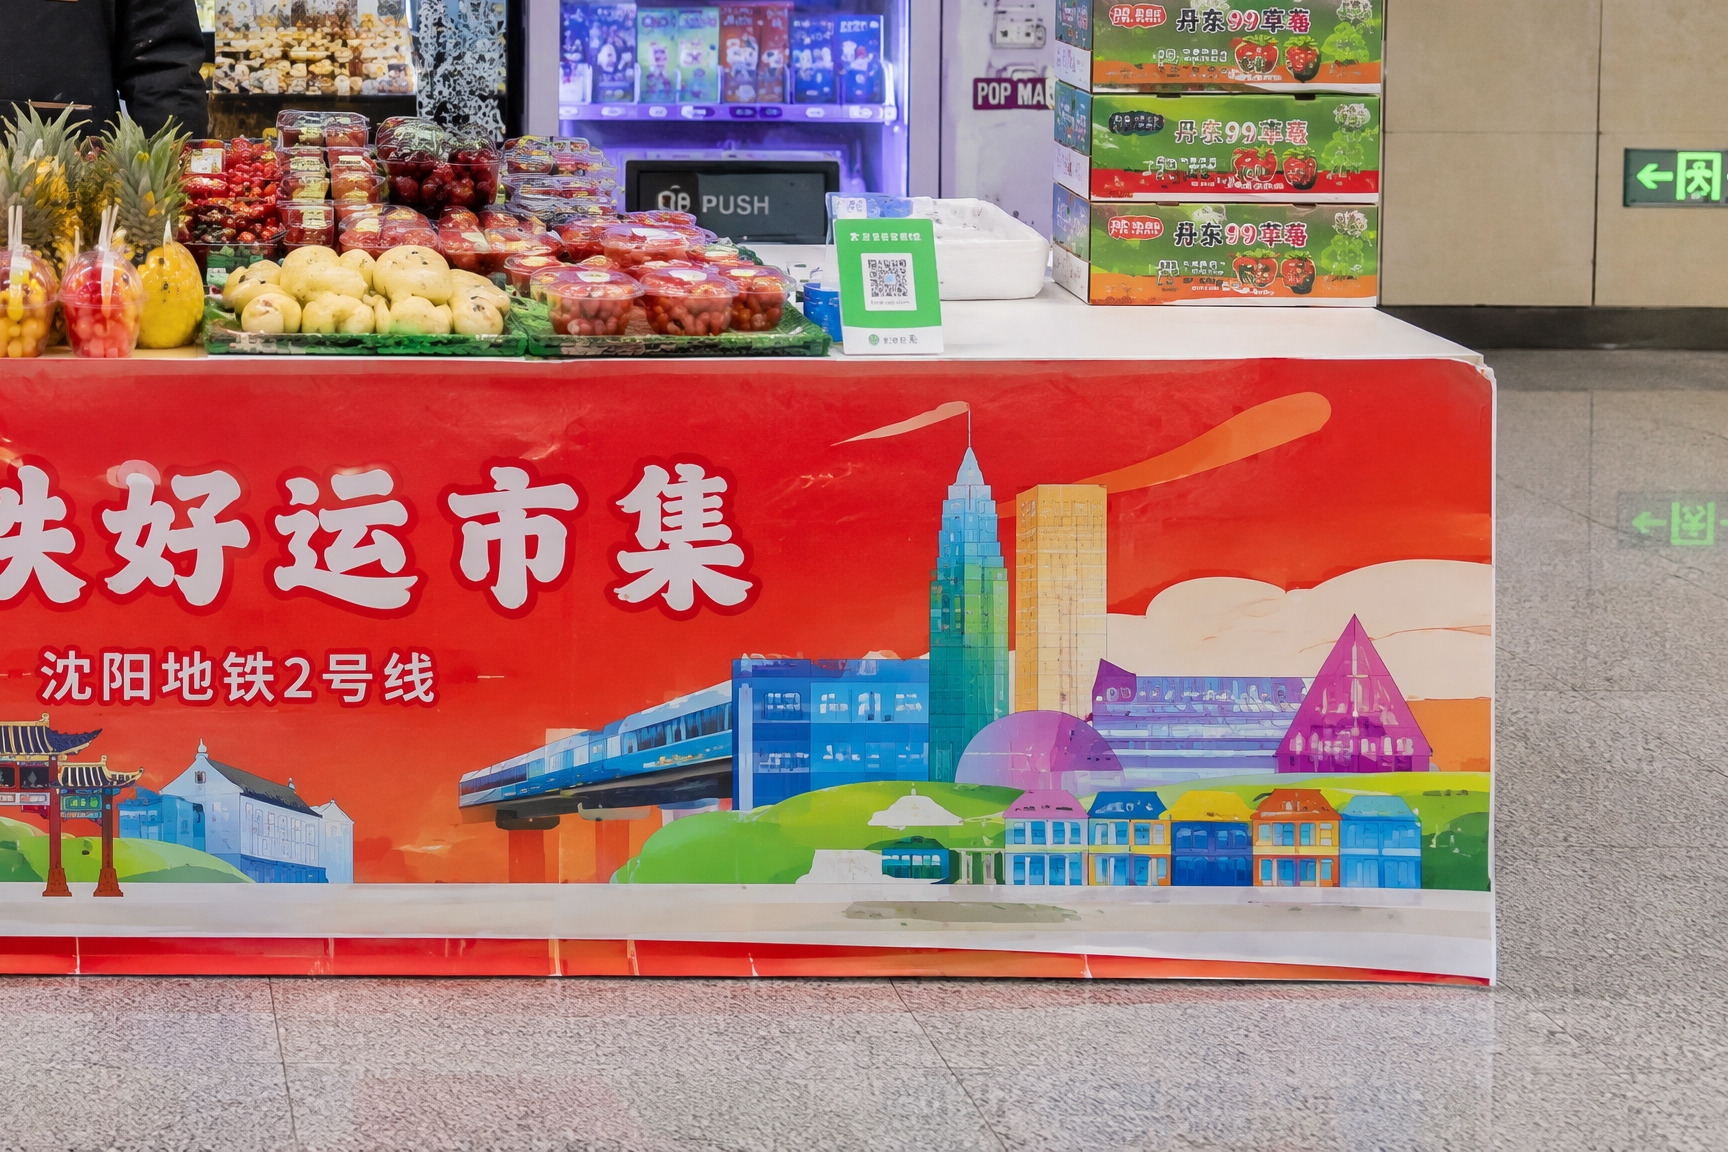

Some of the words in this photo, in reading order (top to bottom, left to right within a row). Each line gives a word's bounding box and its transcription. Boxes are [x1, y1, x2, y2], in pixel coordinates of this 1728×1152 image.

[977, 82, 1012, 106] POP
[702, 194, 770, 215] PUSH
[40, 650, 436, 704] 沈阳地铁2号线
